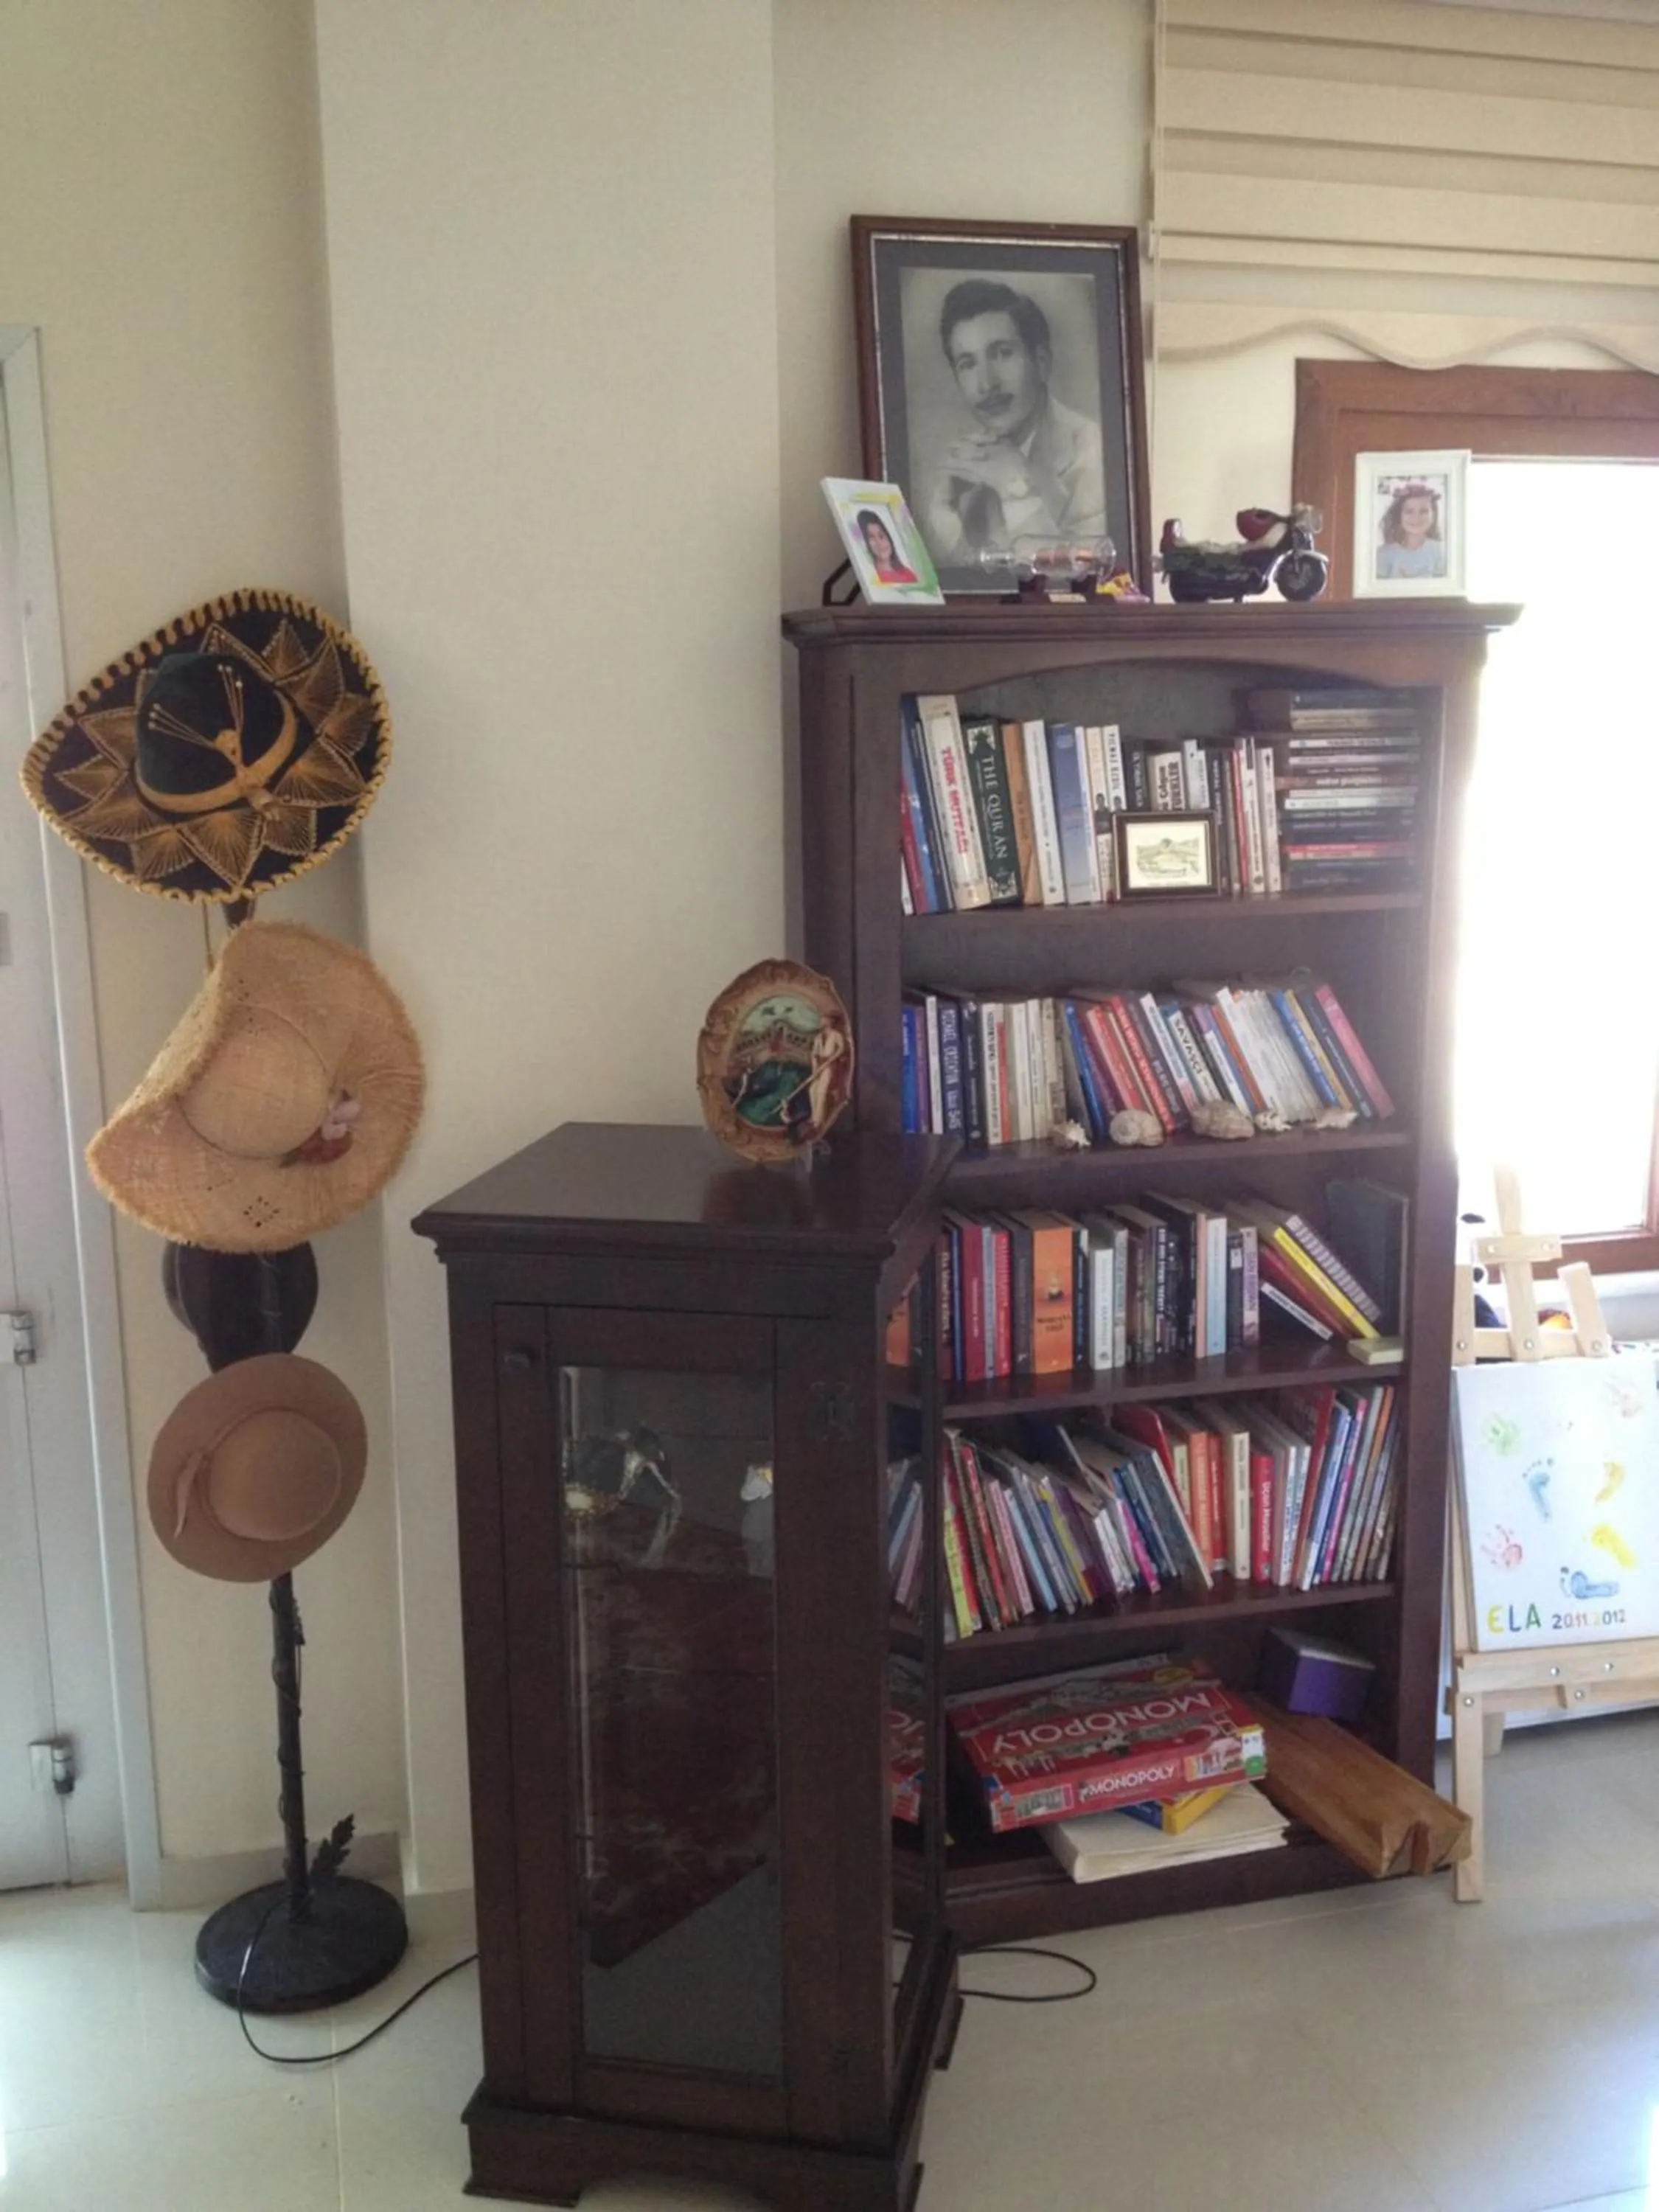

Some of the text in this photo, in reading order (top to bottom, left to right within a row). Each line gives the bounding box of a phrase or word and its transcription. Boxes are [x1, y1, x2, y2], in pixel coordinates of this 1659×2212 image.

[981, 756, 998, 789] THE
[1487, 1602, 1542, 1634] ELA
[992, 1692, 1211, 1754] MONOPOLY
[1088, 1765, 1175, 1795] MONOPOLY
